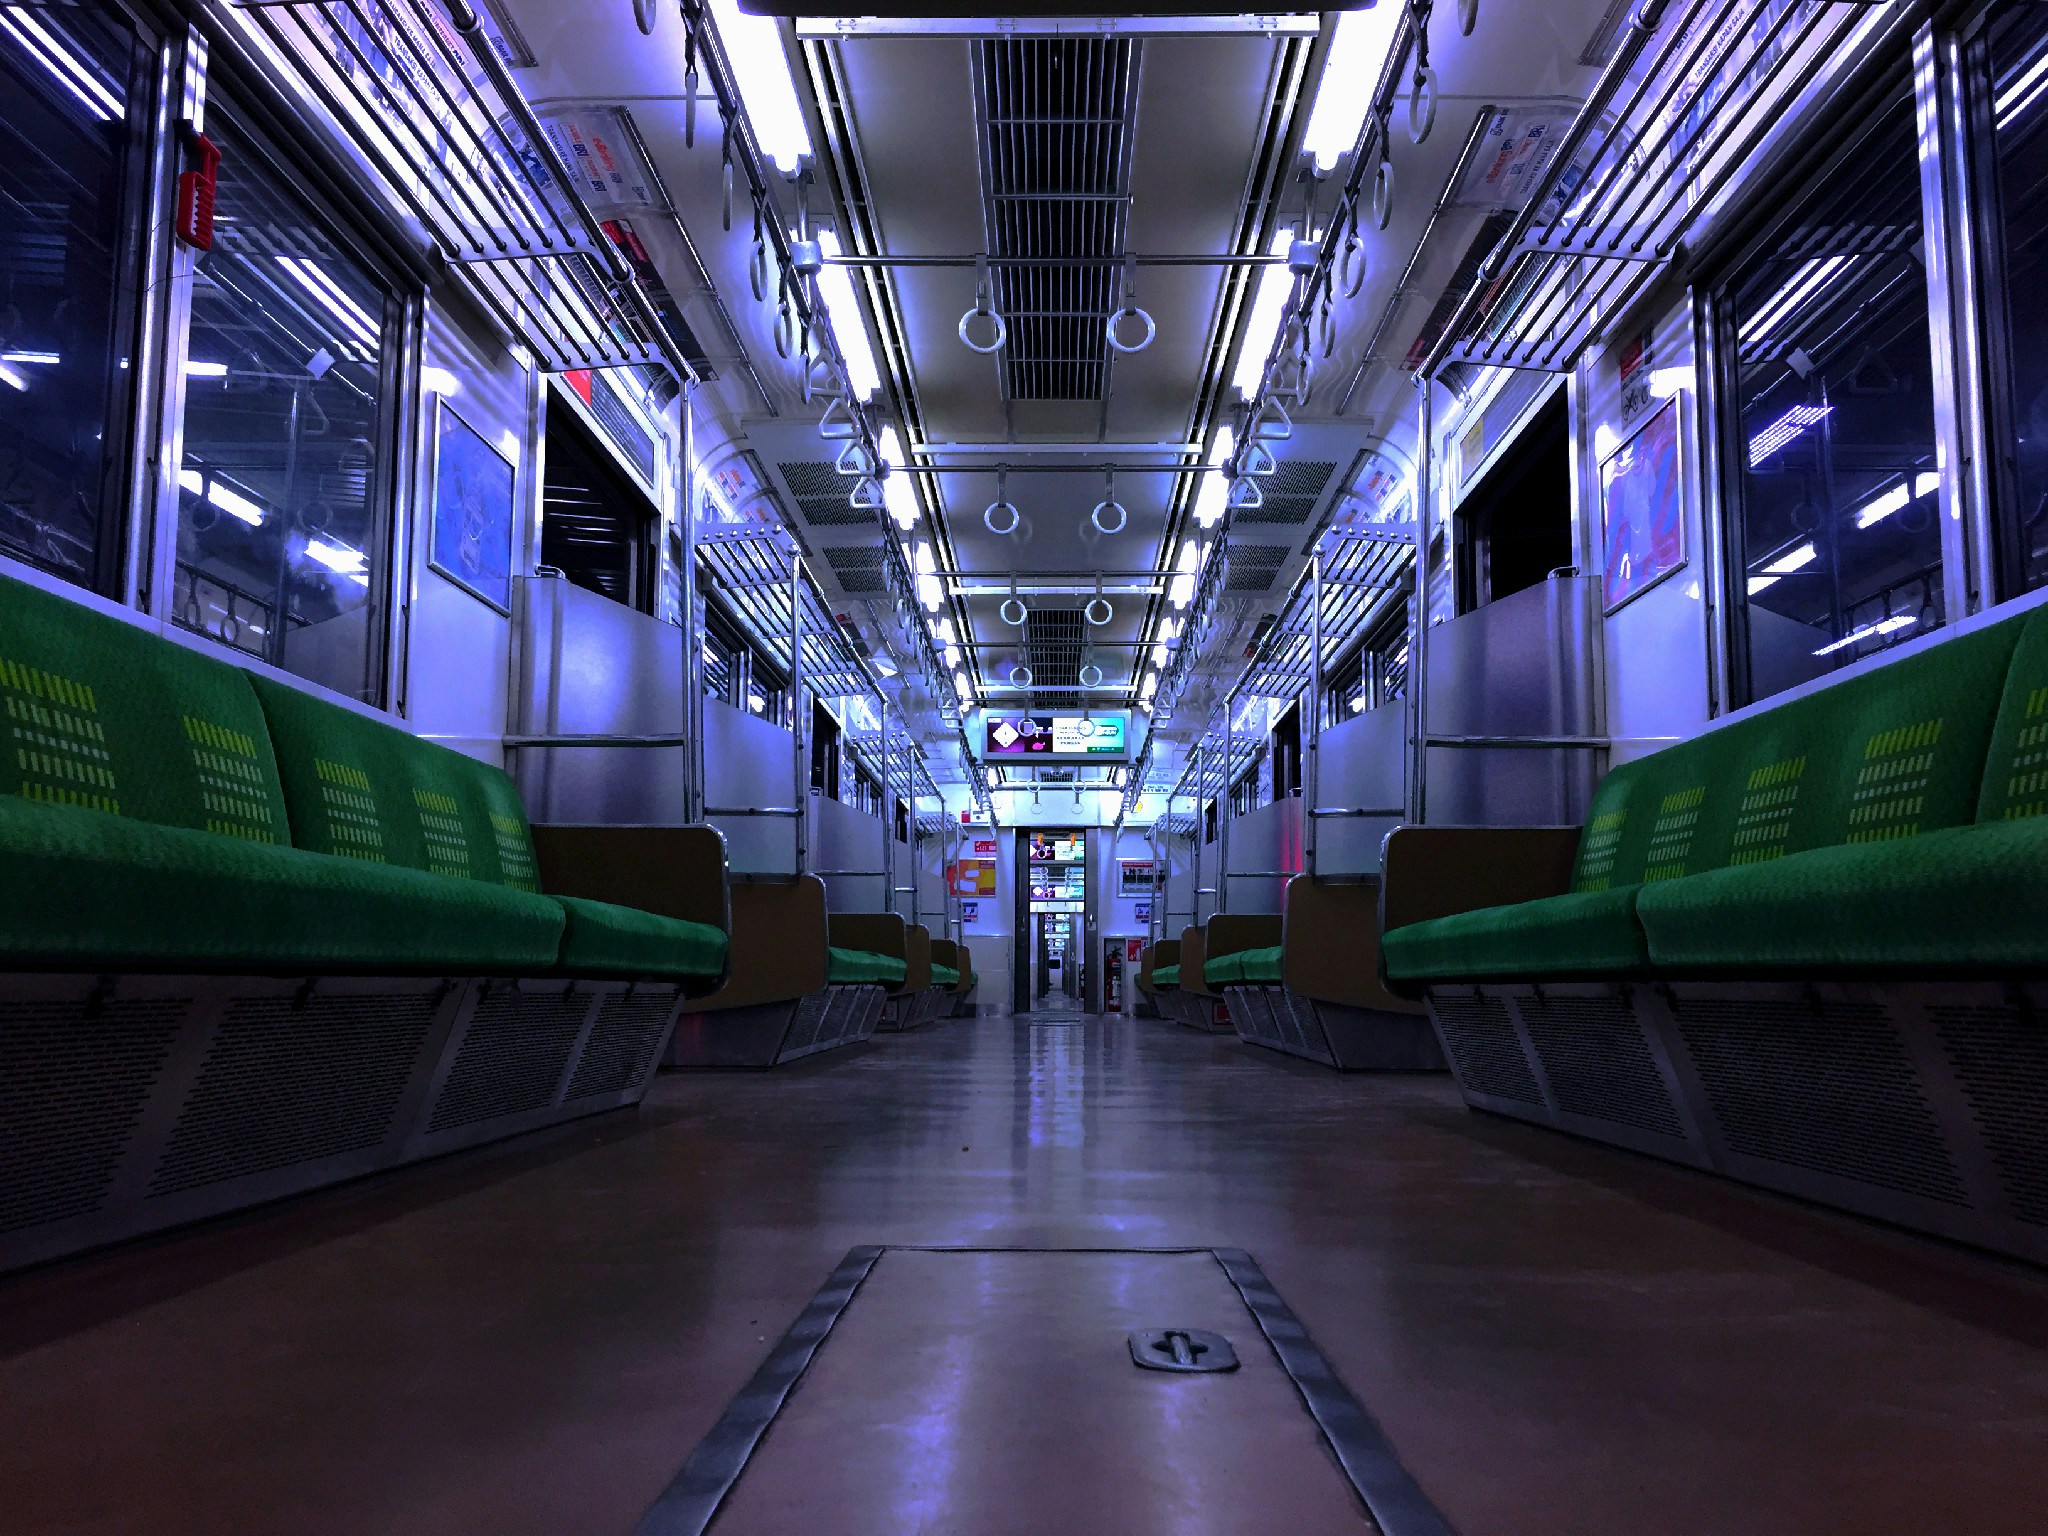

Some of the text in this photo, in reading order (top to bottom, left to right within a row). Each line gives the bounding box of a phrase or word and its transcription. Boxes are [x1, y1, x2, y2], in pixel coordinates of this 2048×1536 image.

[386, 0, 407, 27] ANSAKSI
[1695, 45, 1718, 78] TRANSAKSI
[1730, 8, 1745, 26] SAJA
[573, 143, 589, 156] BRI
[591, 180, 607, 191] BRI
